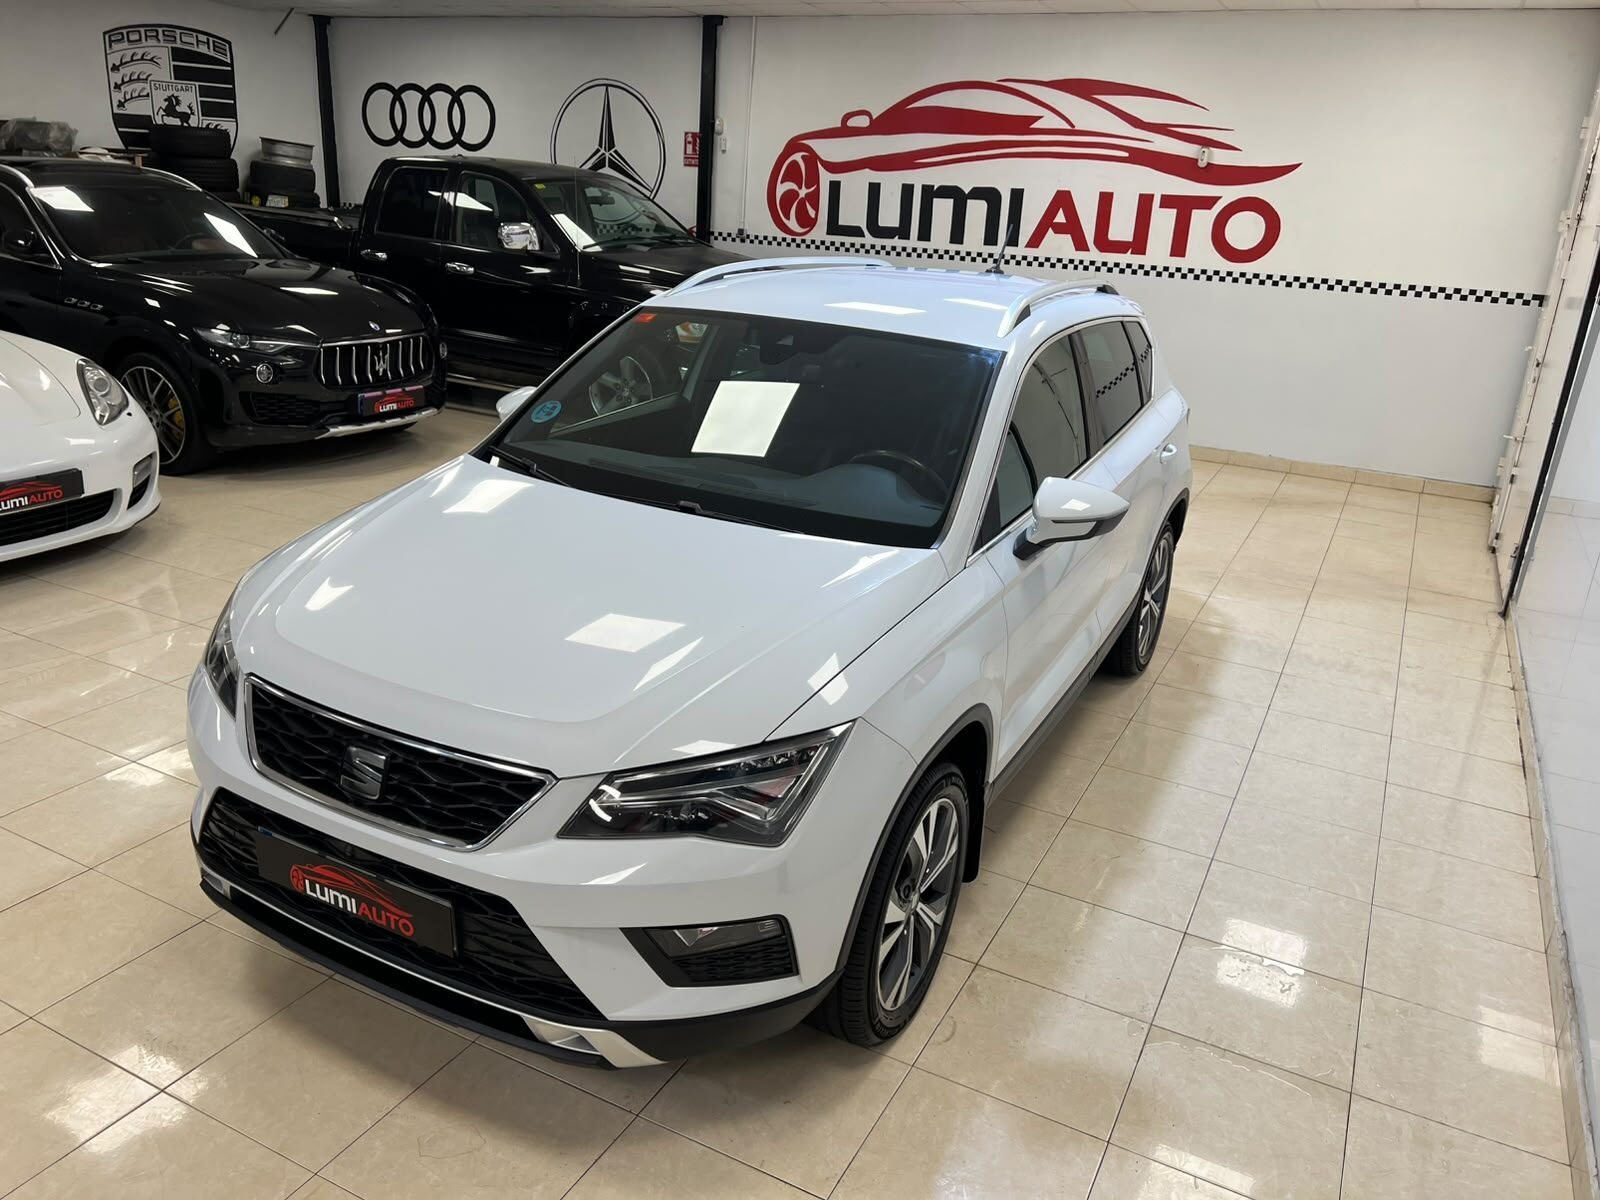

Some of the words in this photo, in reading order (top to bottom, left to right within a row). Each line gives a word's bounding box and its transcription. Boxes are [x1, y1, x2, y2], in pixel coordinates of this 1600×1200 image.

[107, 28, 229, 59] PORSCHE
[153, 82, 194, 94] STUTTGART
[0, 489, 63, 511] UMIAUTO
